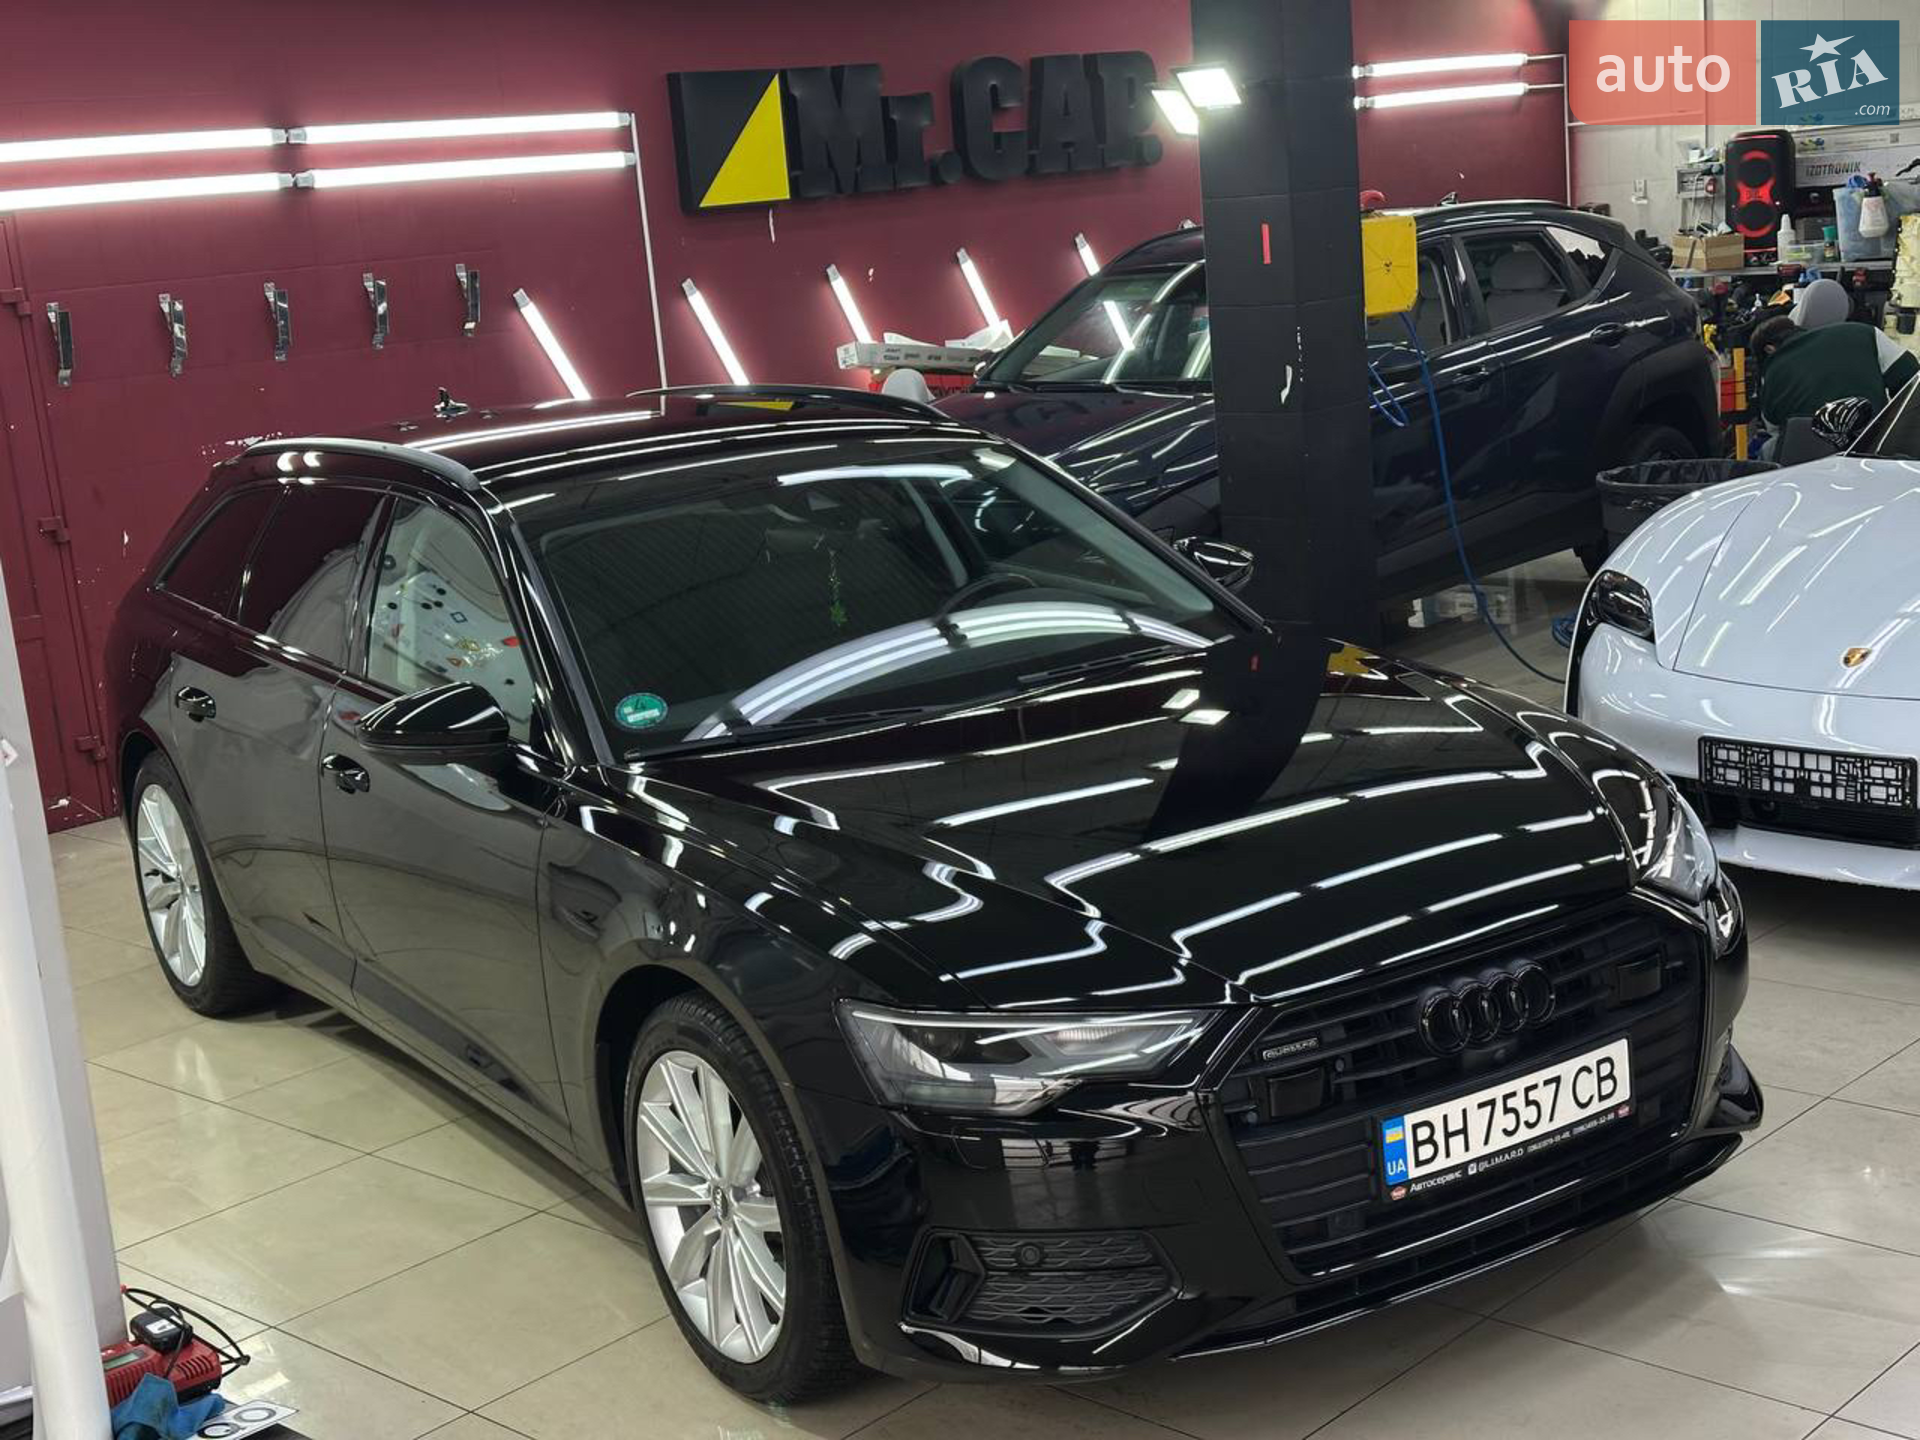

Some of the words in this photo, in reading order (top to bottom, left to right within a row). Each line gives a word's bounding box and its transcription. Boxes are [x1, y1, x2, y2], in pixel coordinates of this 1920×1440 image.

[1805, 160, 1862, 177] IZOTRONIK
[1411, 1107, 1470, 1168] BH
[1476, 1074, 1562, 1147] 7557
[1571, 1056, 1618, 1110] CB
[1387, 1158, 1407, 1176] UA
[1409, 1170, 1463, 1193] Автосервис
